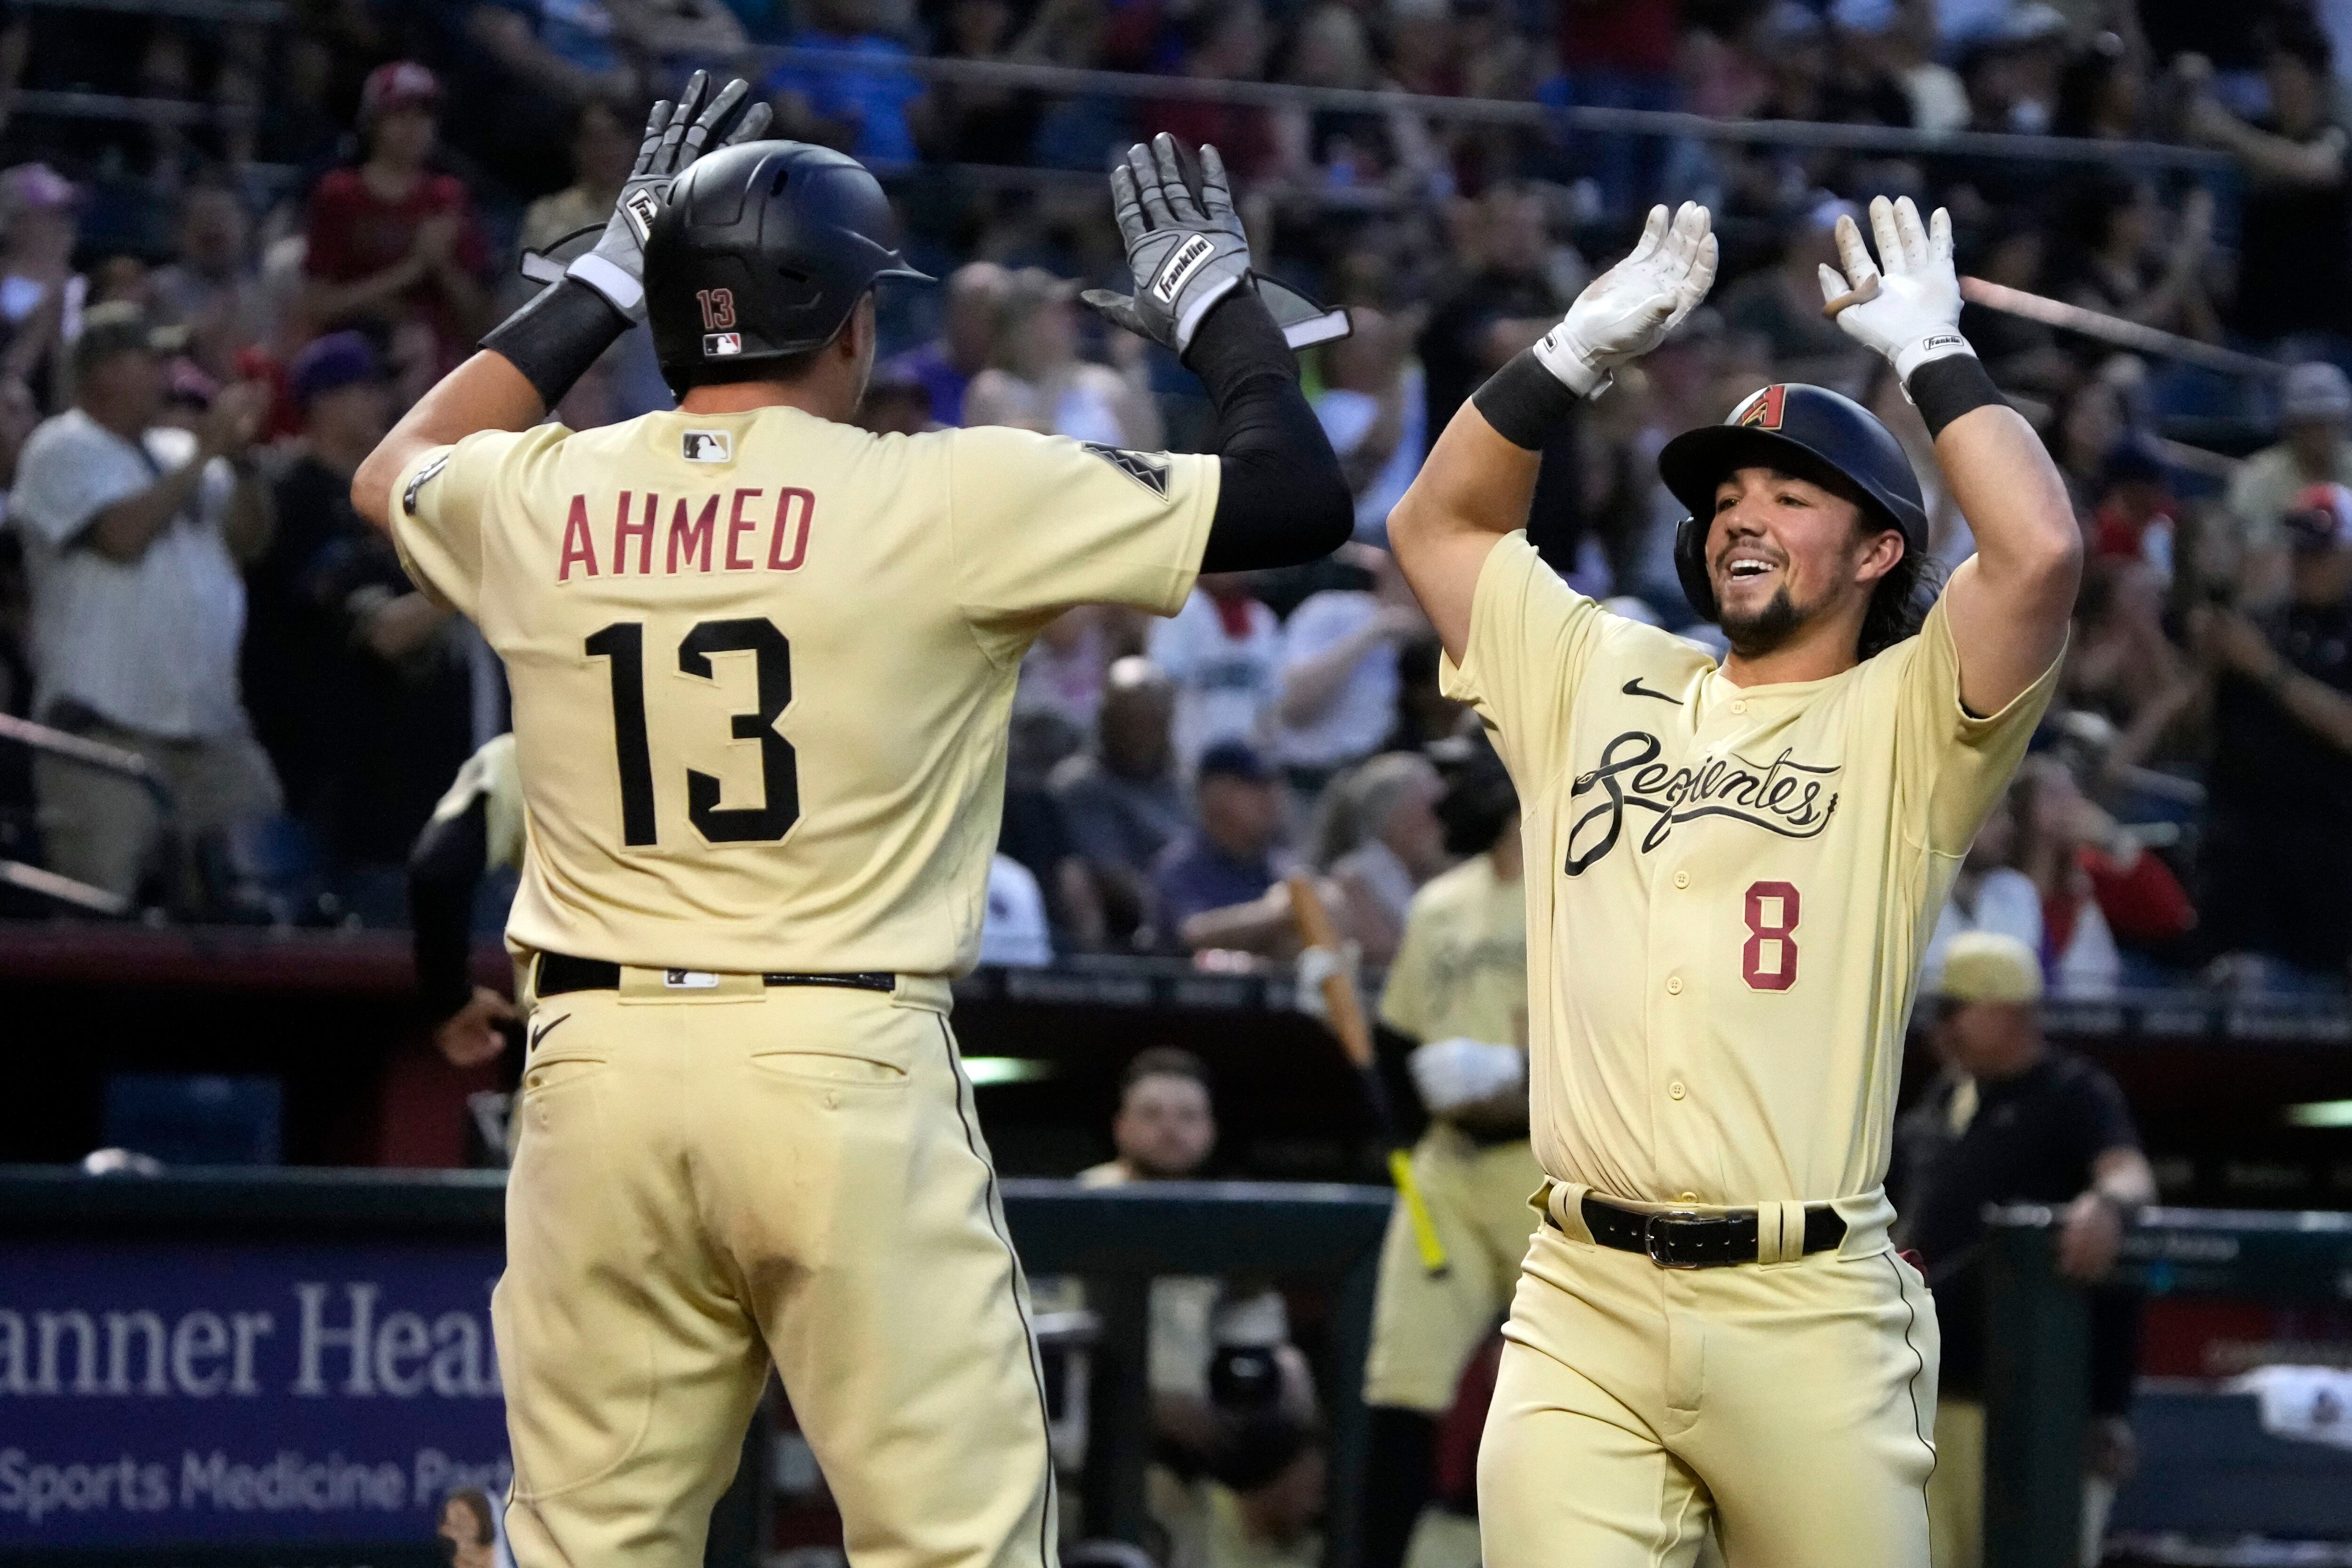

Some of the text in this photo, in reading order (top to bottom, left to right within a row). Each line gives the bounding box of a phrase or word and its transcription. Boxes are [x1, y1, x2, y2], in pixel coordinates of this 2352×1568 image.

[696, 288, 736, 329] 13
[1159, 239, 1208, 300] Franklin
[558, 486, 816, 582] AHMED
[584, 617, 800, 846] 13
[1565, 731, 1841, 876] Sepientes
[1742, 881, 1800, 991] 8
[0, 1447, 171, 1526] Sports
[182, 1449, 407, 1511] Medicine
